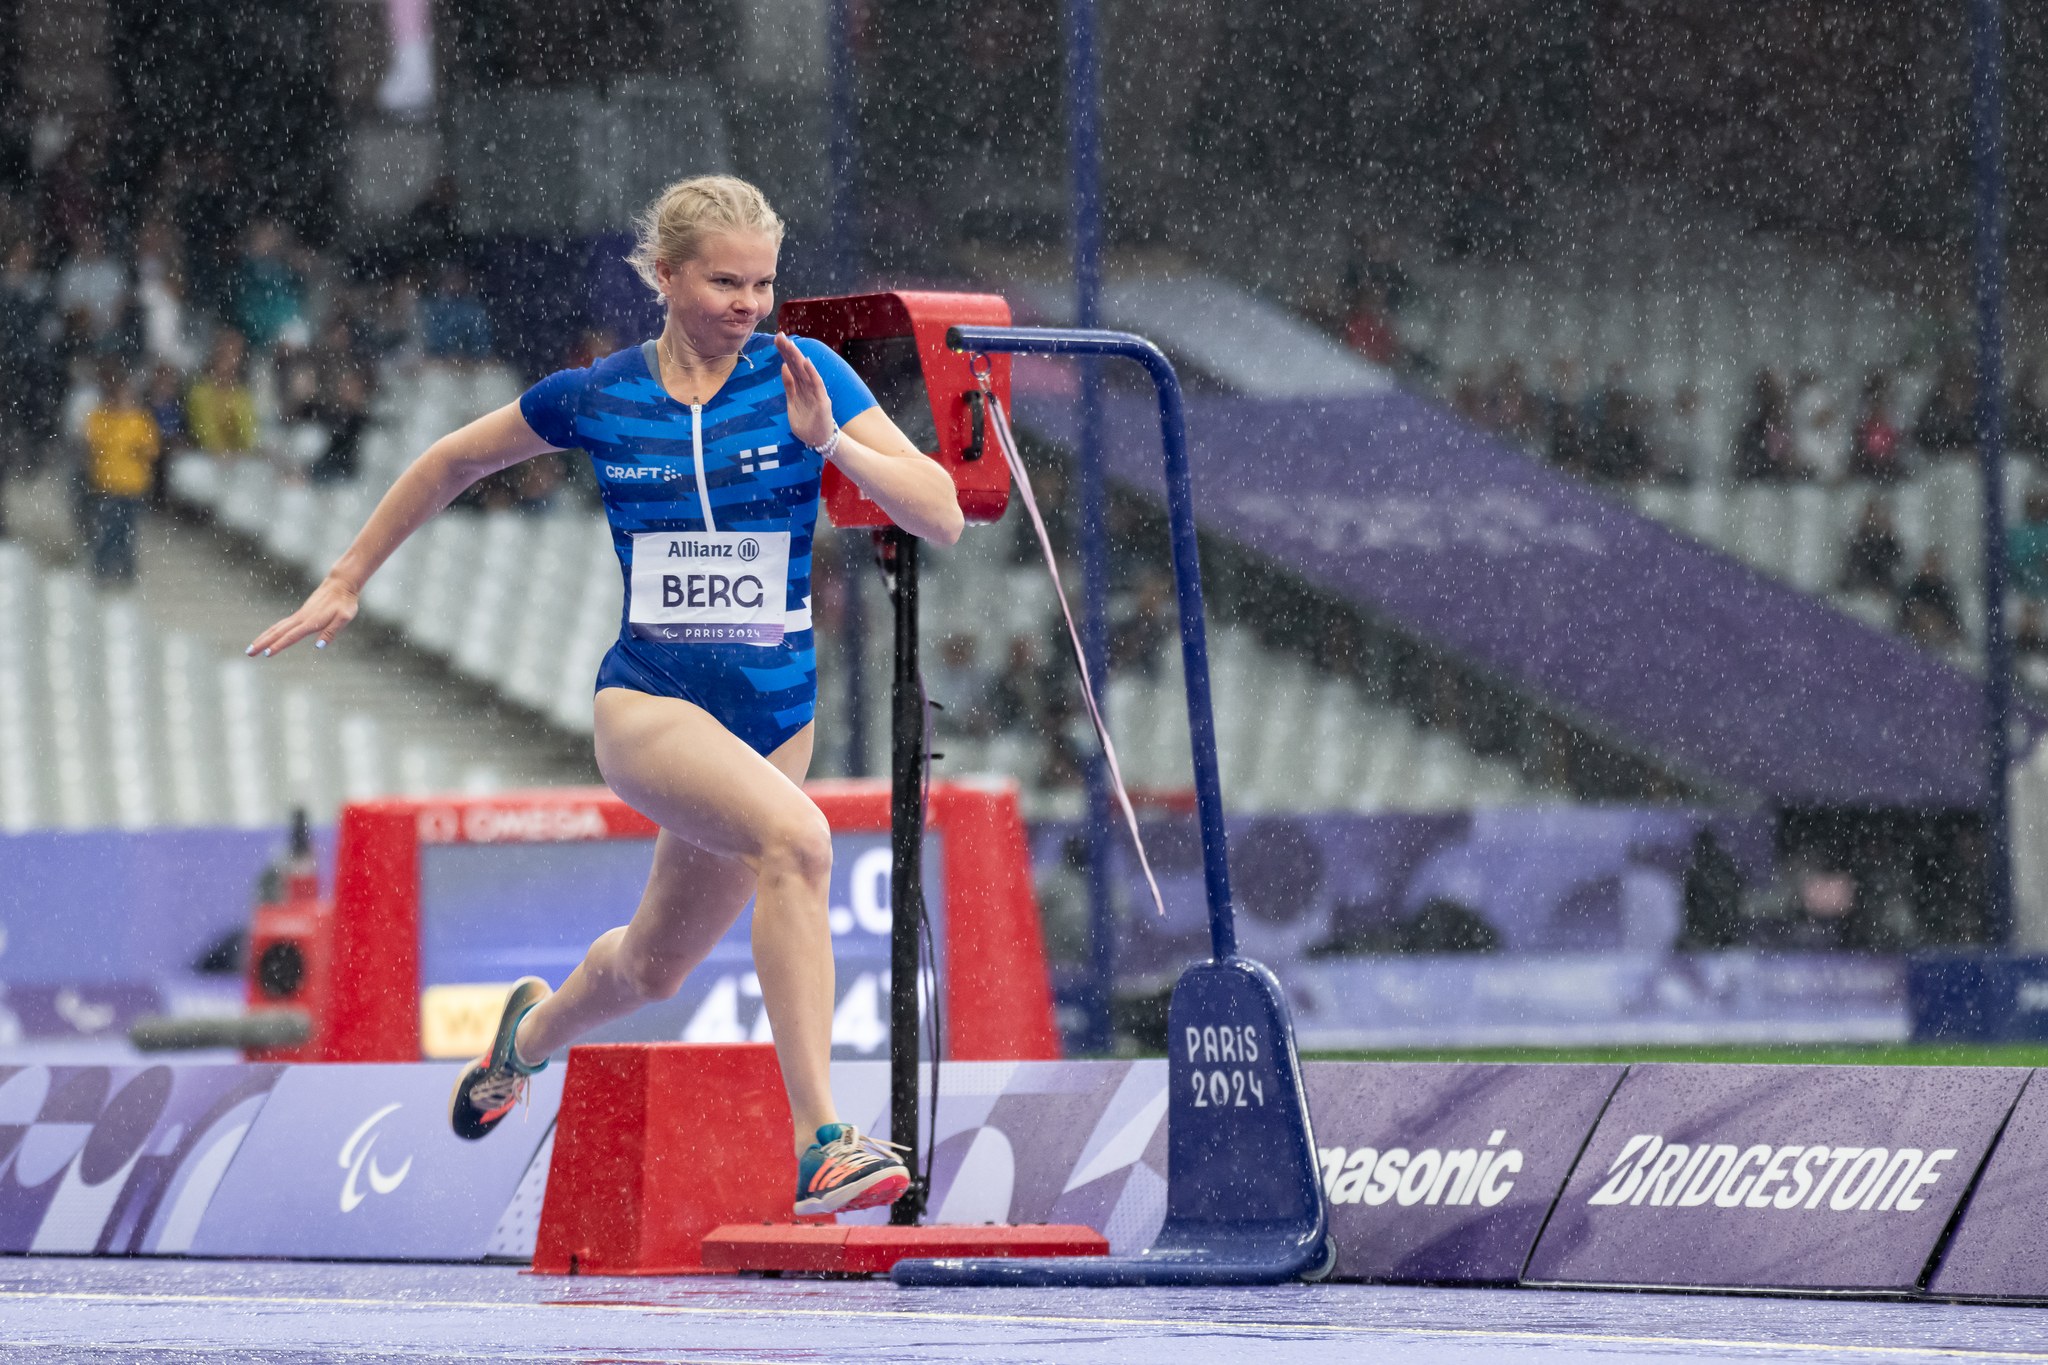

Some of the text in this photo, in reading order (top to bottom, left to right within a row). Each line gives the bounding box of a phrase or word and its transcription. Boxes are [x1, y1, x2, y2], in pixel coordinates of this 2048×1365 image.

[605, 464, 662, 480] CRAFT
[668, 541, 733, 558] Allianz
[662, 574, 764, 608] BERG
[685, 628, 760, 638] PARIS 2024
[1191, 1070, 1264, 1107] 2024
[1587, 1135, 1958, 1211] BRIDGESTONE
